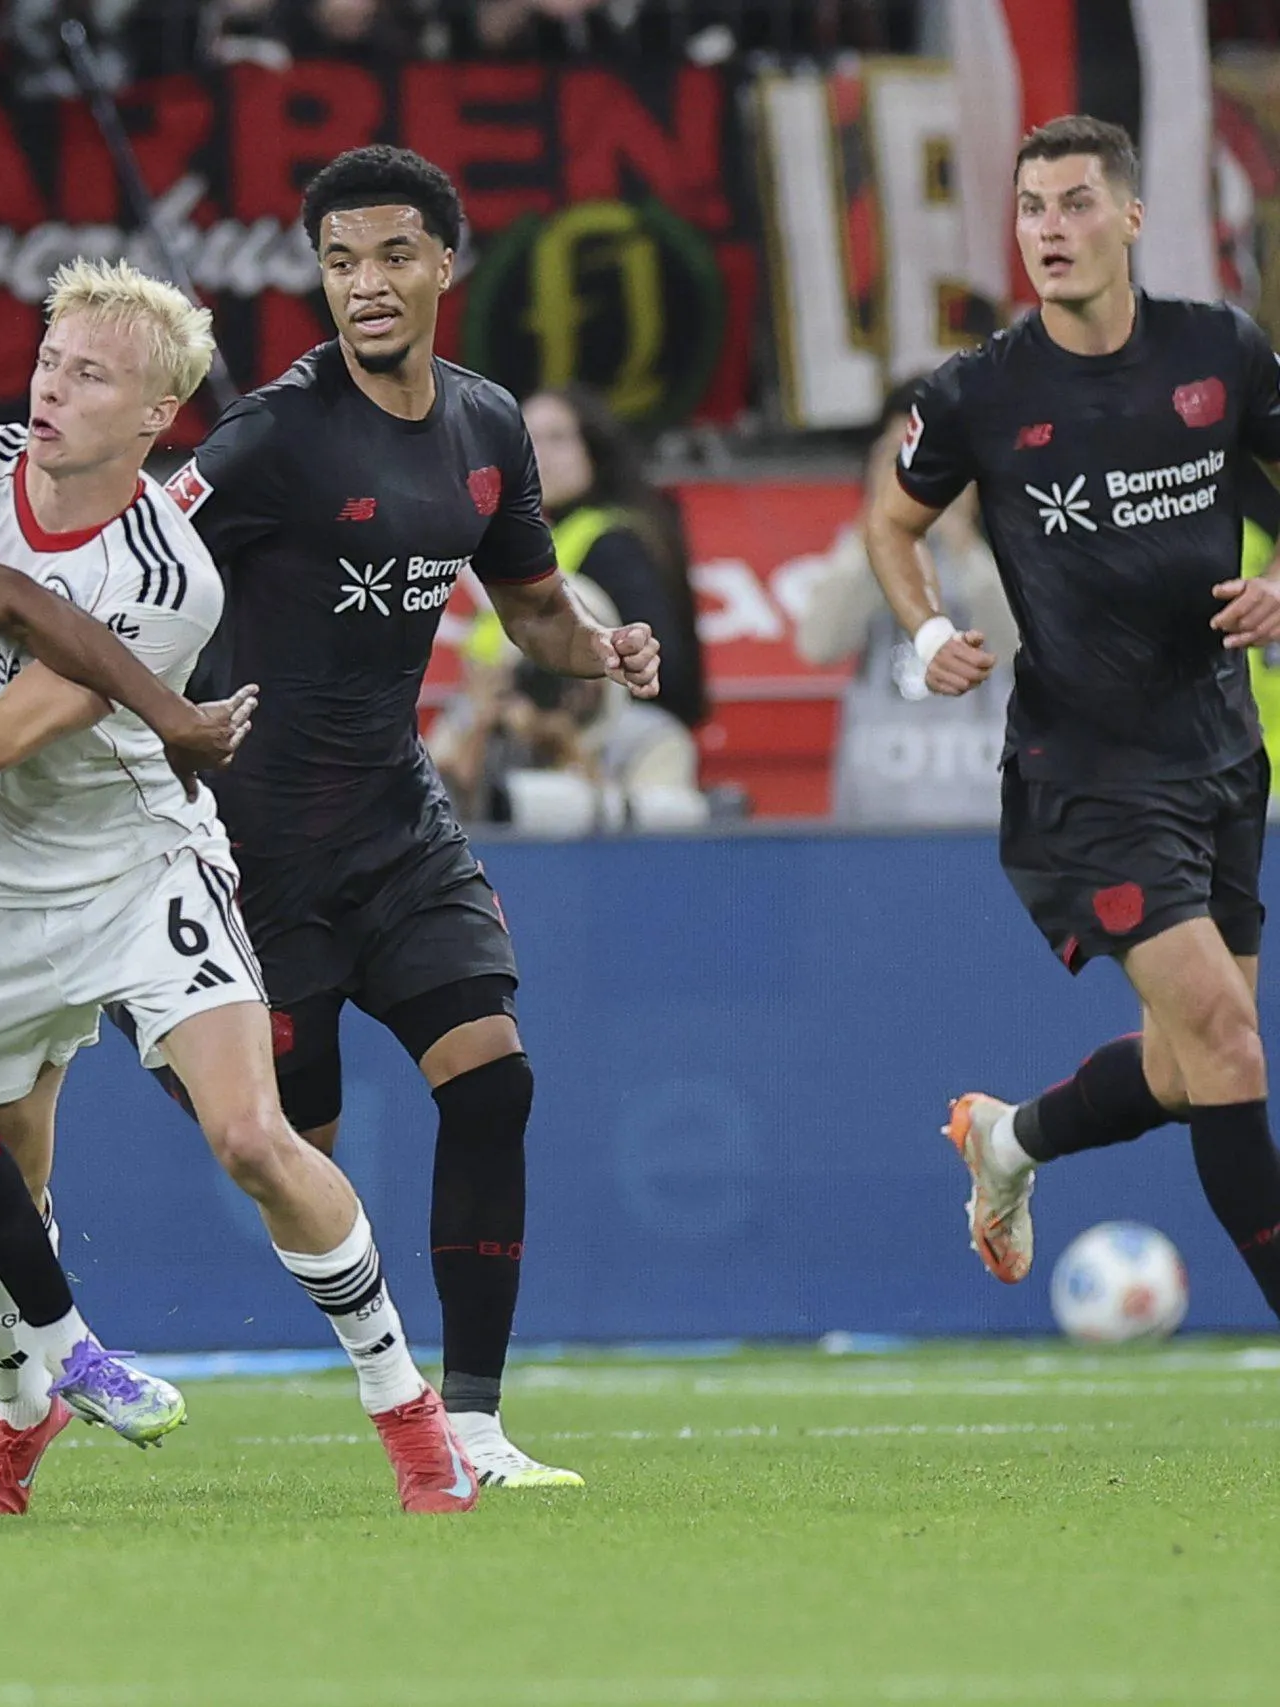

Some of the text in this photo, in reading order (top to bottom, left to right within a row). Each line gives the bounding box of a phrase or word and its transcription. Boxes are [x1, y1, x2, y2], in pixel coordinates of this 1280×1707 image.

[1105, 449, 1225, 499] Barmenia
[1112, 484, 1217, 528] Gothaer
[406, 554, 473, 581] Barm
[402, 582, 456, 612] Goth
[167, 895, 210, 957] 6
